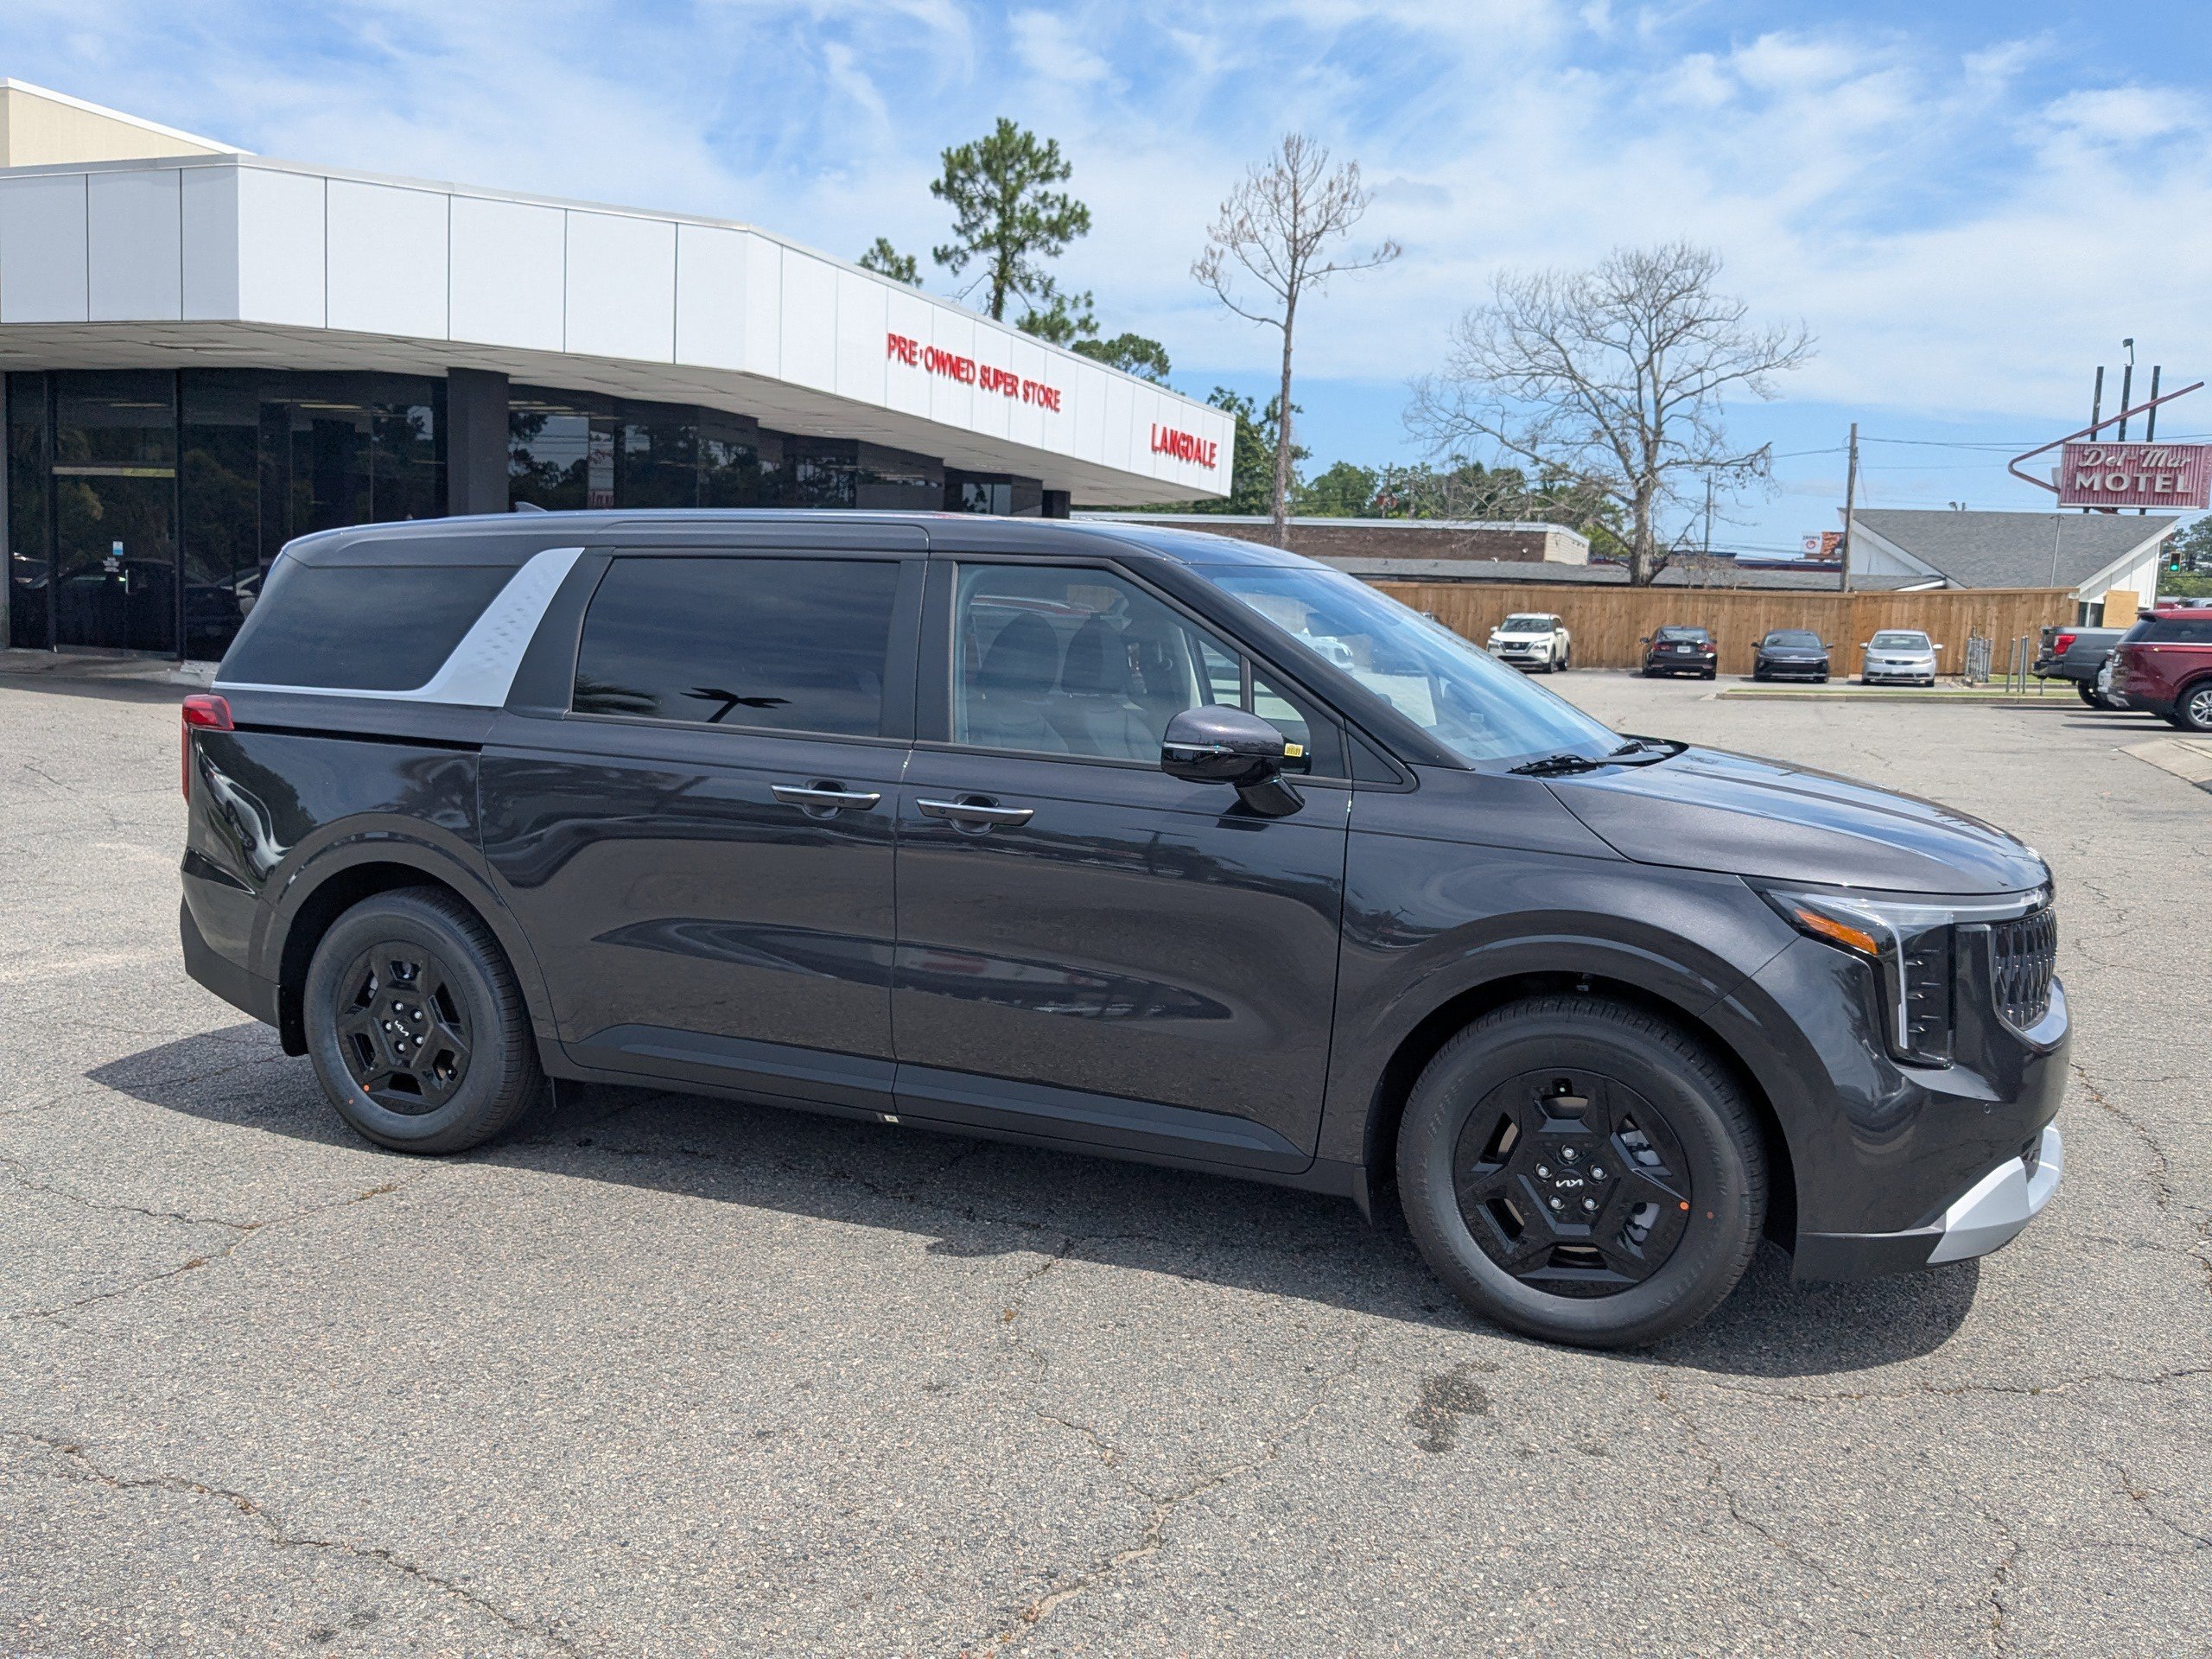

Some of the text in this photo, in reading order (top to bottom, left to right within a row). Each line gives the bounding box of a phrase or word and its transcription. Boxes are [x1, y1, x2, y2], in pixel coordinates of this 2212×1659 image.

[887, 333, 1062, 413] PRE-OWNED SUPER STORE
[1151, 423, 1217, 469] LANGDALE
[2075, 471, 2194, 493] MOTEL
